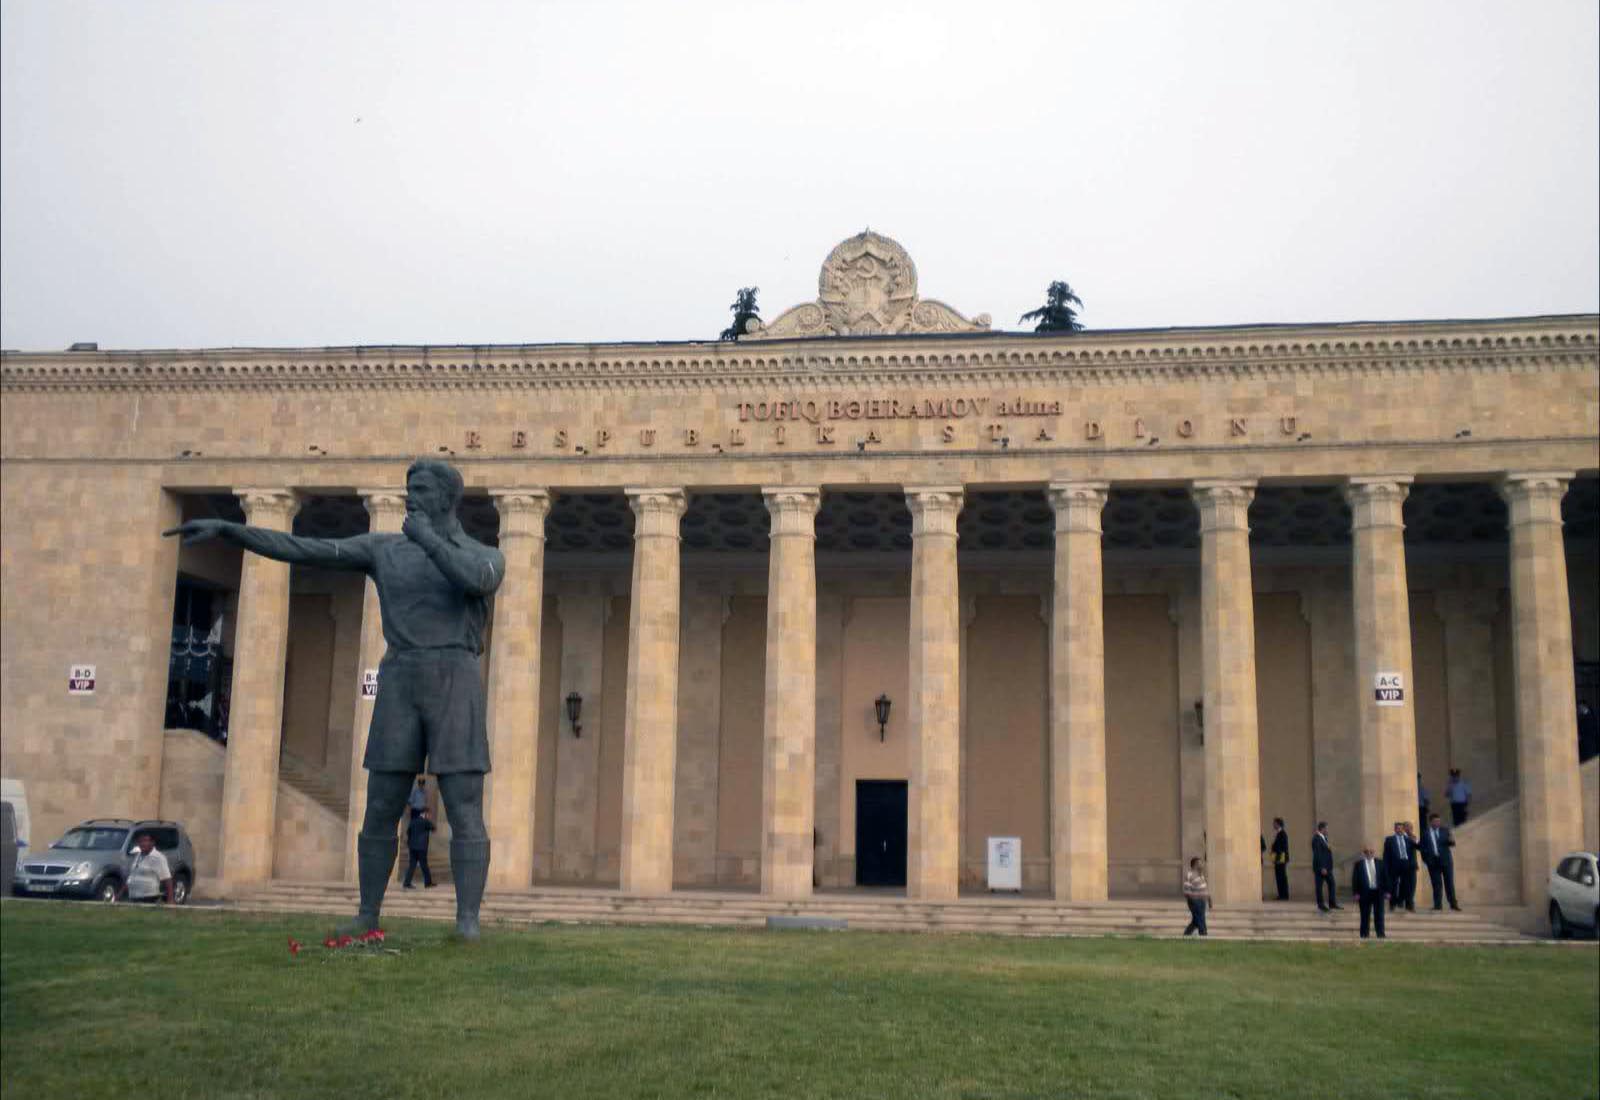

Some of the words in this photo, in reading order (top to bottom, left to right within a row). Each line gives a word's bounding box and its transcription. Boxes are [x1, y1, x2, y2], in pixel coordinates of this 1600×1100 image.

[75, 680, 90, 689] VIP
[1380, 676, 1400, 687] A-C
[1380, 689, 1400, 700] VIP
